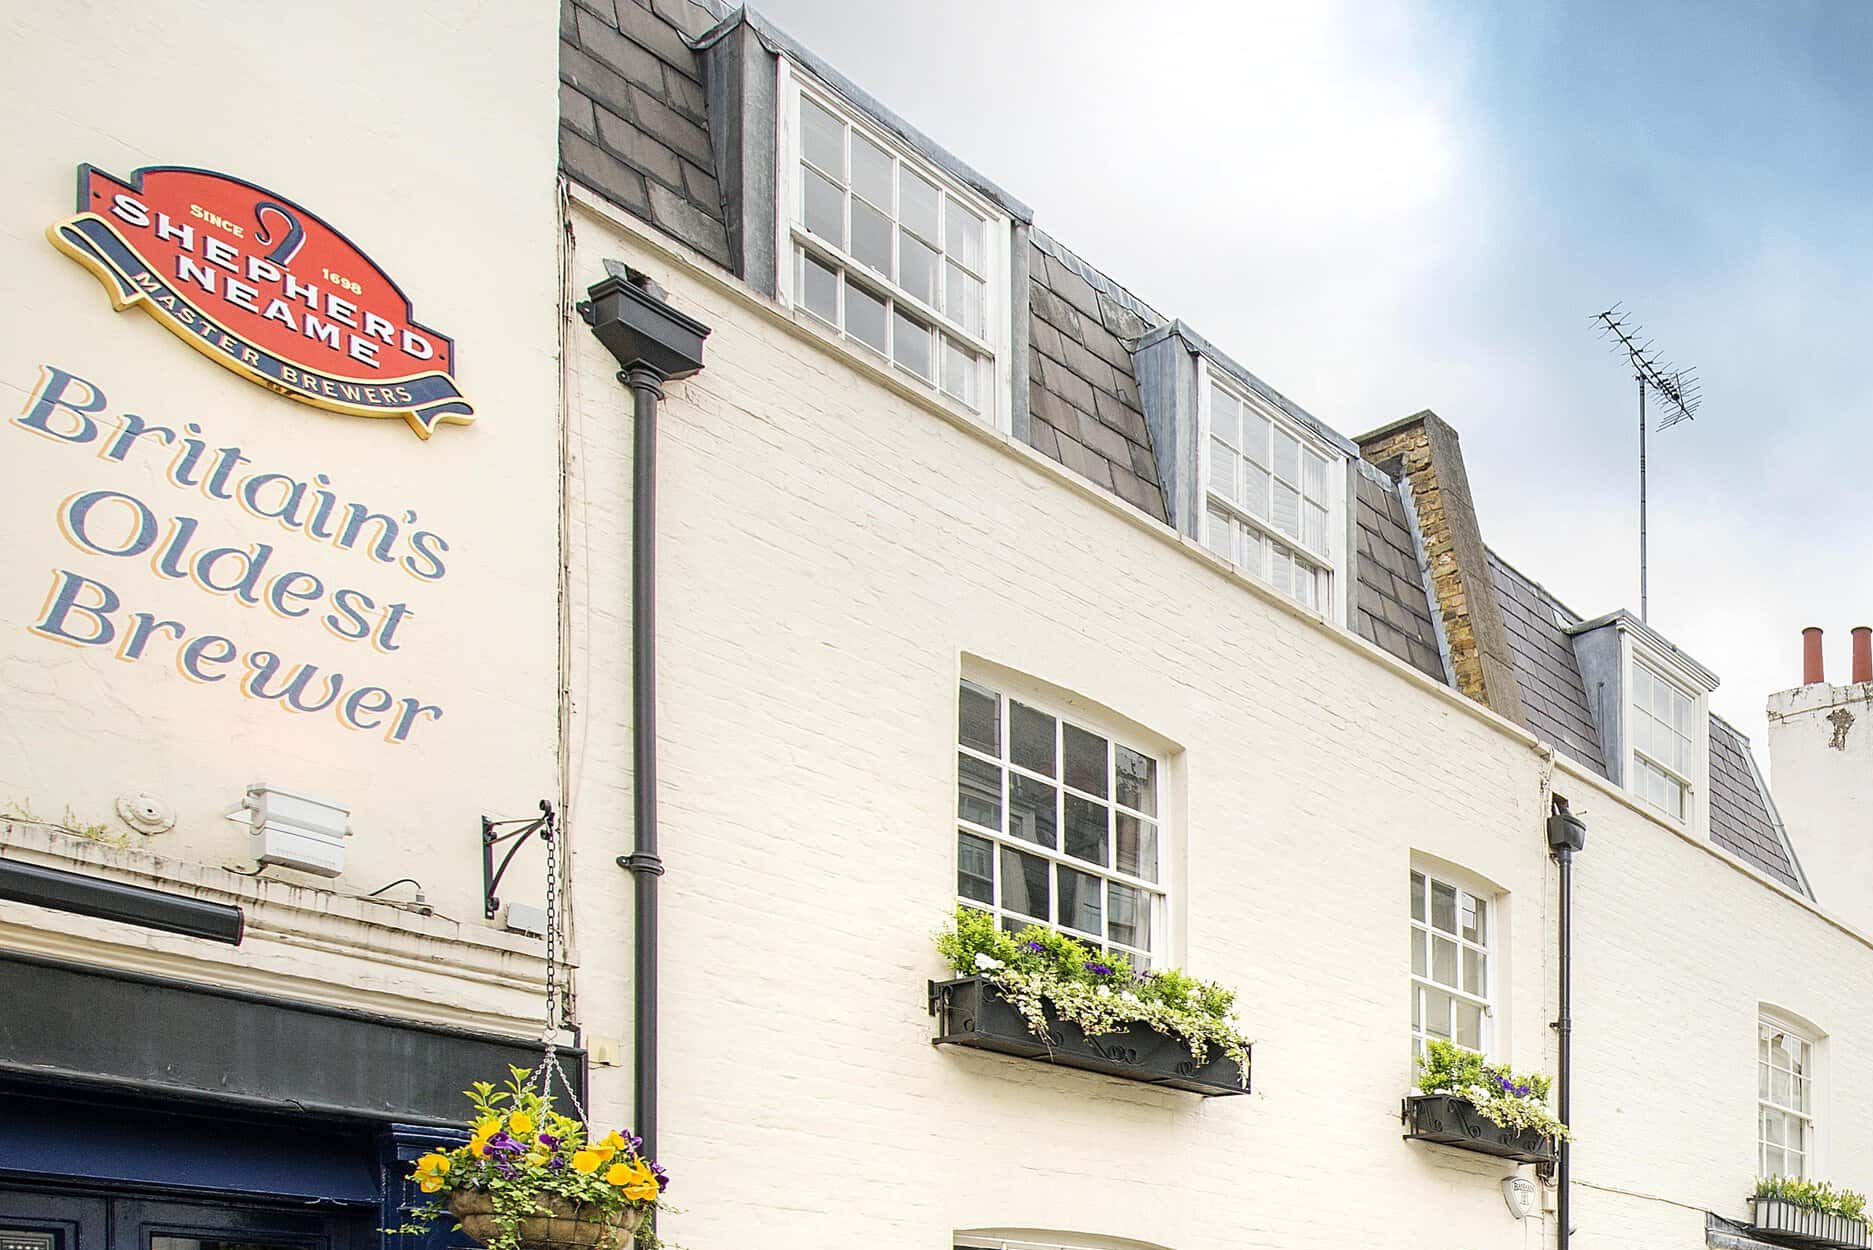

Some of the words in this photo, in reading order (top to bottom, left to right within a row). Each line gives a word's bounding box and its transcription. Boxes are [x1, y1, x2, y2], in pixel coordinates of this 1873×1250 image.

[111, 191, 433, 362] SHEPHERD
[131, 271, 260, 367] MASTER
[281, 365, 412, 404] BREWERS
[176, 257, 380, 369] NEAME
[321, 267, 362, 295] 1698
[10, 364, 449, 582] Britain's
[57, 487, 414, 653] Oldest
[27, 568, 443, 744] Brewer
